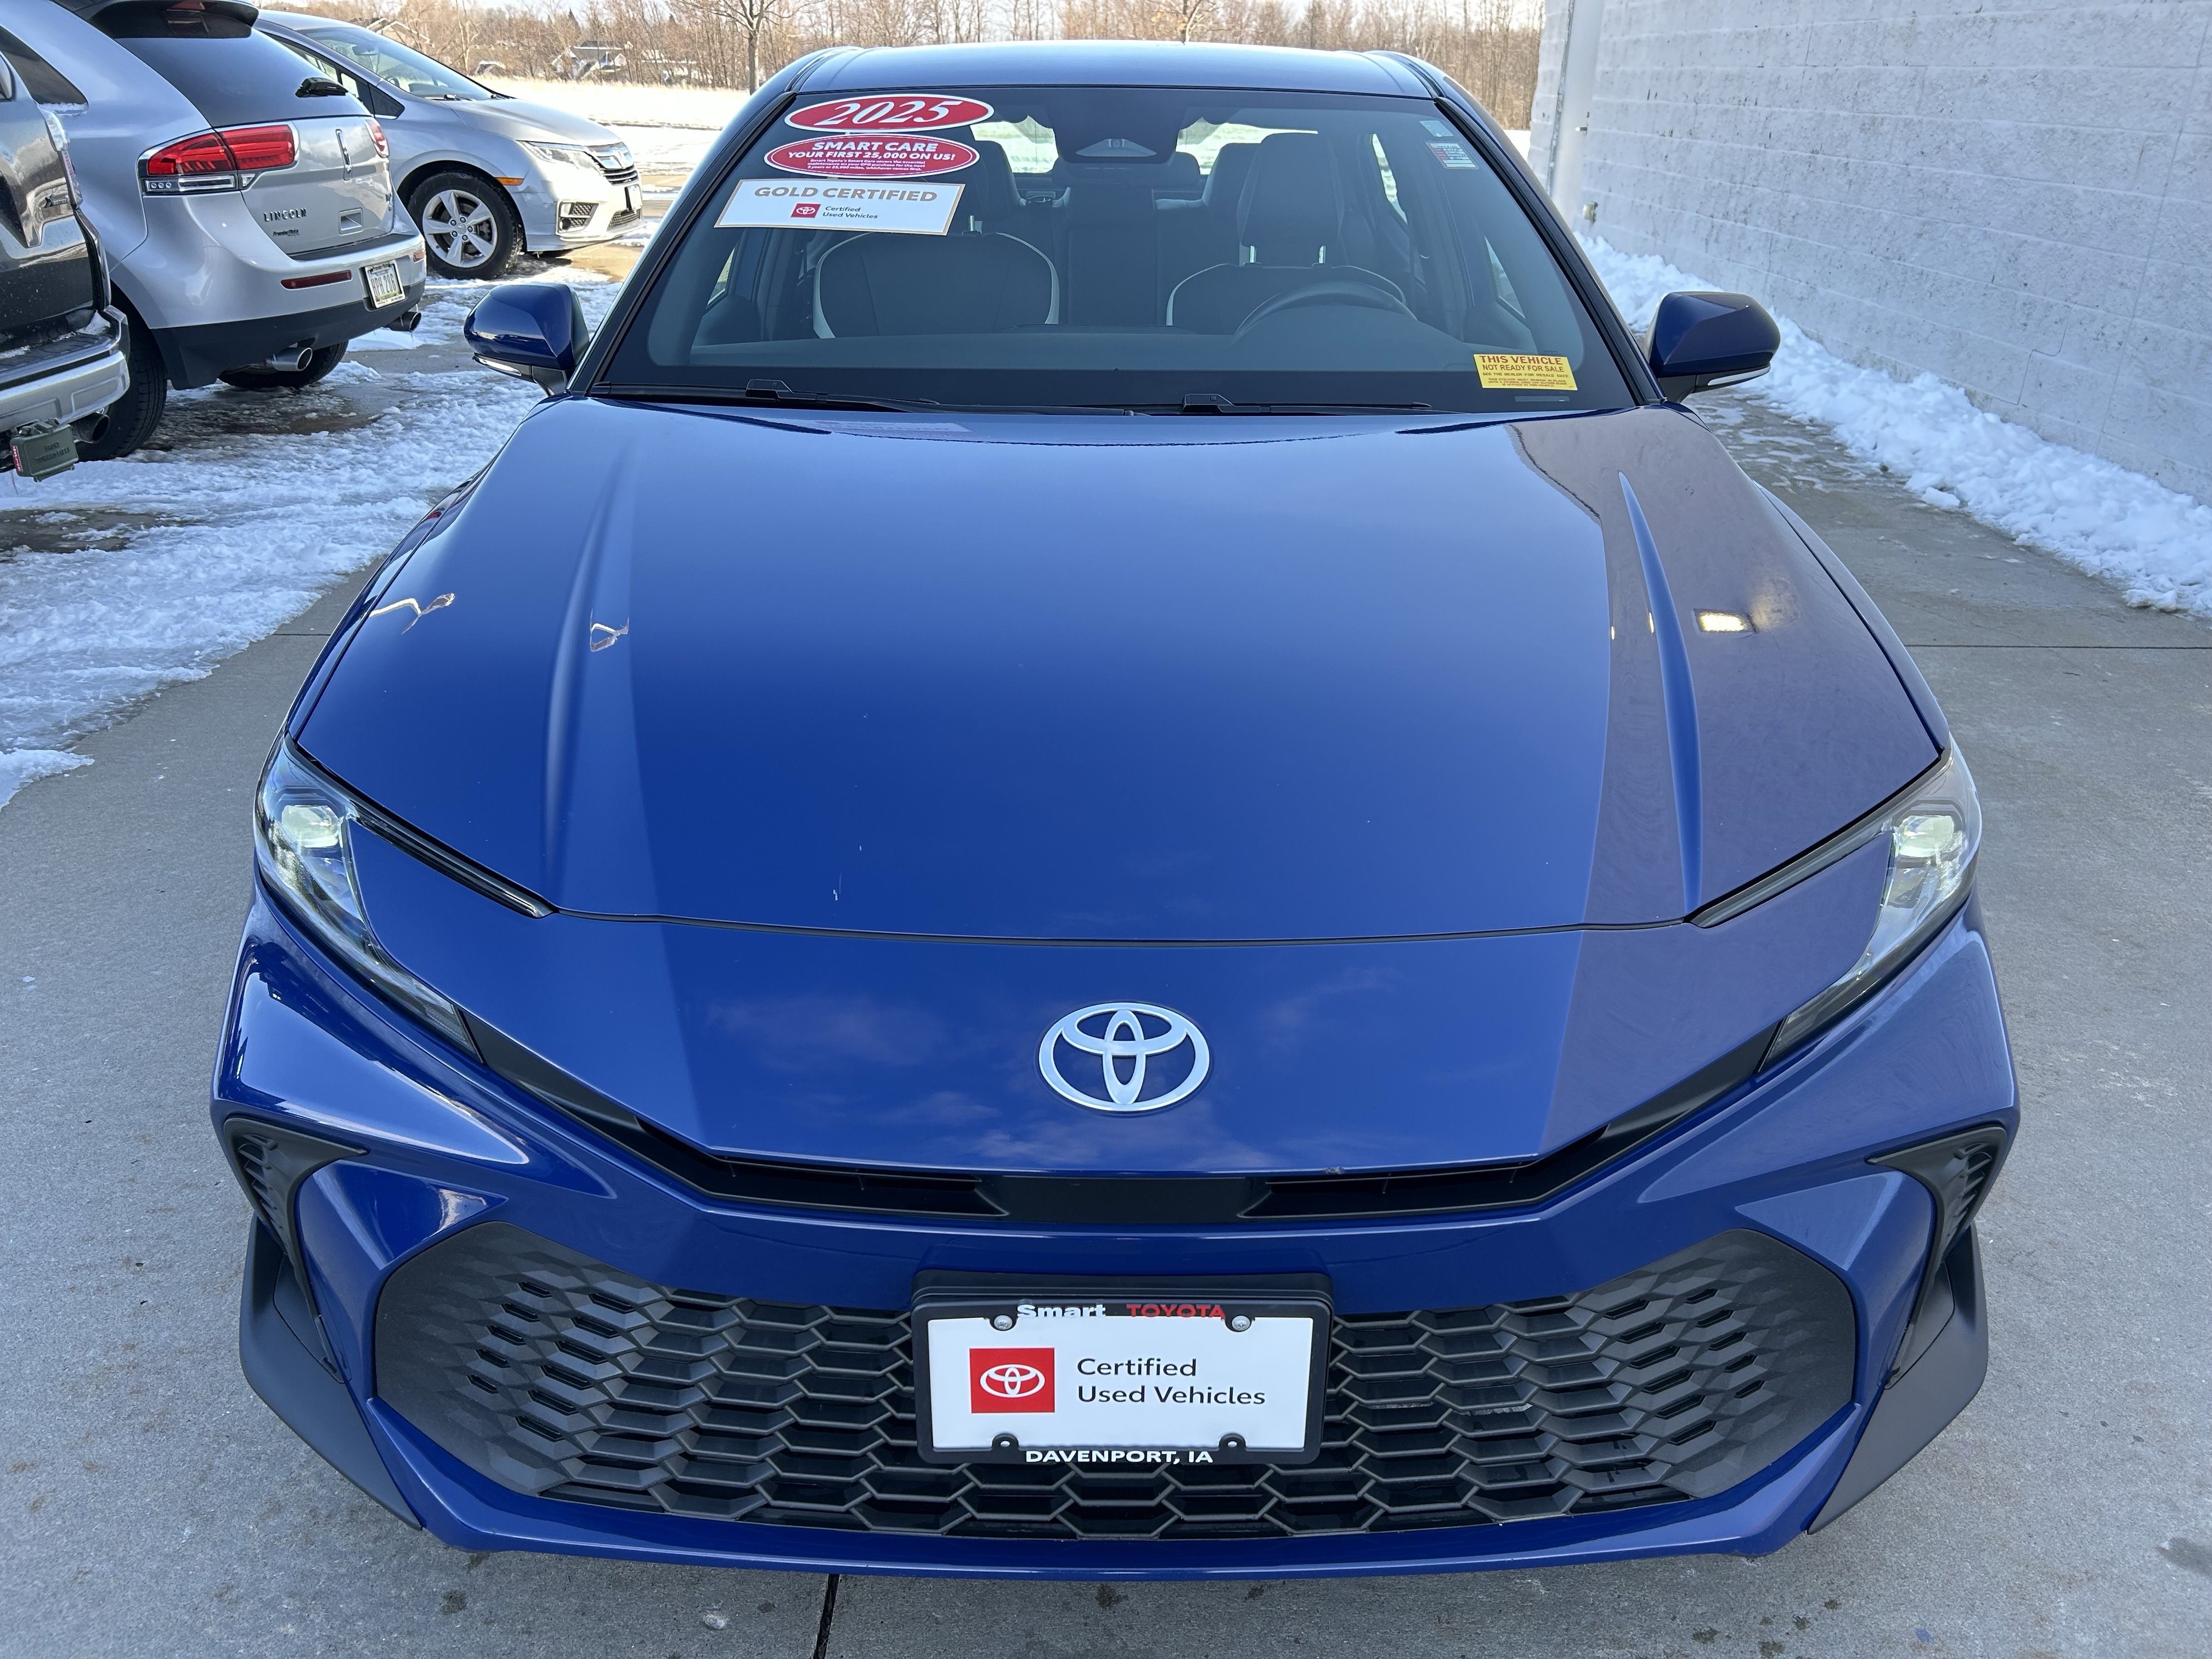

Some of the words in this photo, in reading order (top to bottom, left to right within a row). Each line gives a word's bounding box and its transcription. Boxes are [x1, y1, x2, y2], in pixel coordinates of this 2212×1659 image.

[814, 101, 963, 126] 2025
[812, 142, 883, 150] SMART
[885, 143, 939, 152] CARE
[754, 187, 819, 196] GOLD
[822, 188, 938, 201] CERTIFIED
[263, 207, 307, 222] LINCOLN
[383, 273, 396, 293] 286
[1510, 356, 1563, 365] VEHICLE
[1017, 1304, 1106, 1317] Smart
[1126, 1304, 1226, 1321] TOYOTA
[1077, 1358, 1197, 1376] Certified
[1079, 1385, 1146, 1402] Used
[1154, 1386, 1265, 1404] Vehicles
[1026, 1451, 1181, 1465] DAVENPORT,
[1189, 1451, 1214, 1463] IA
